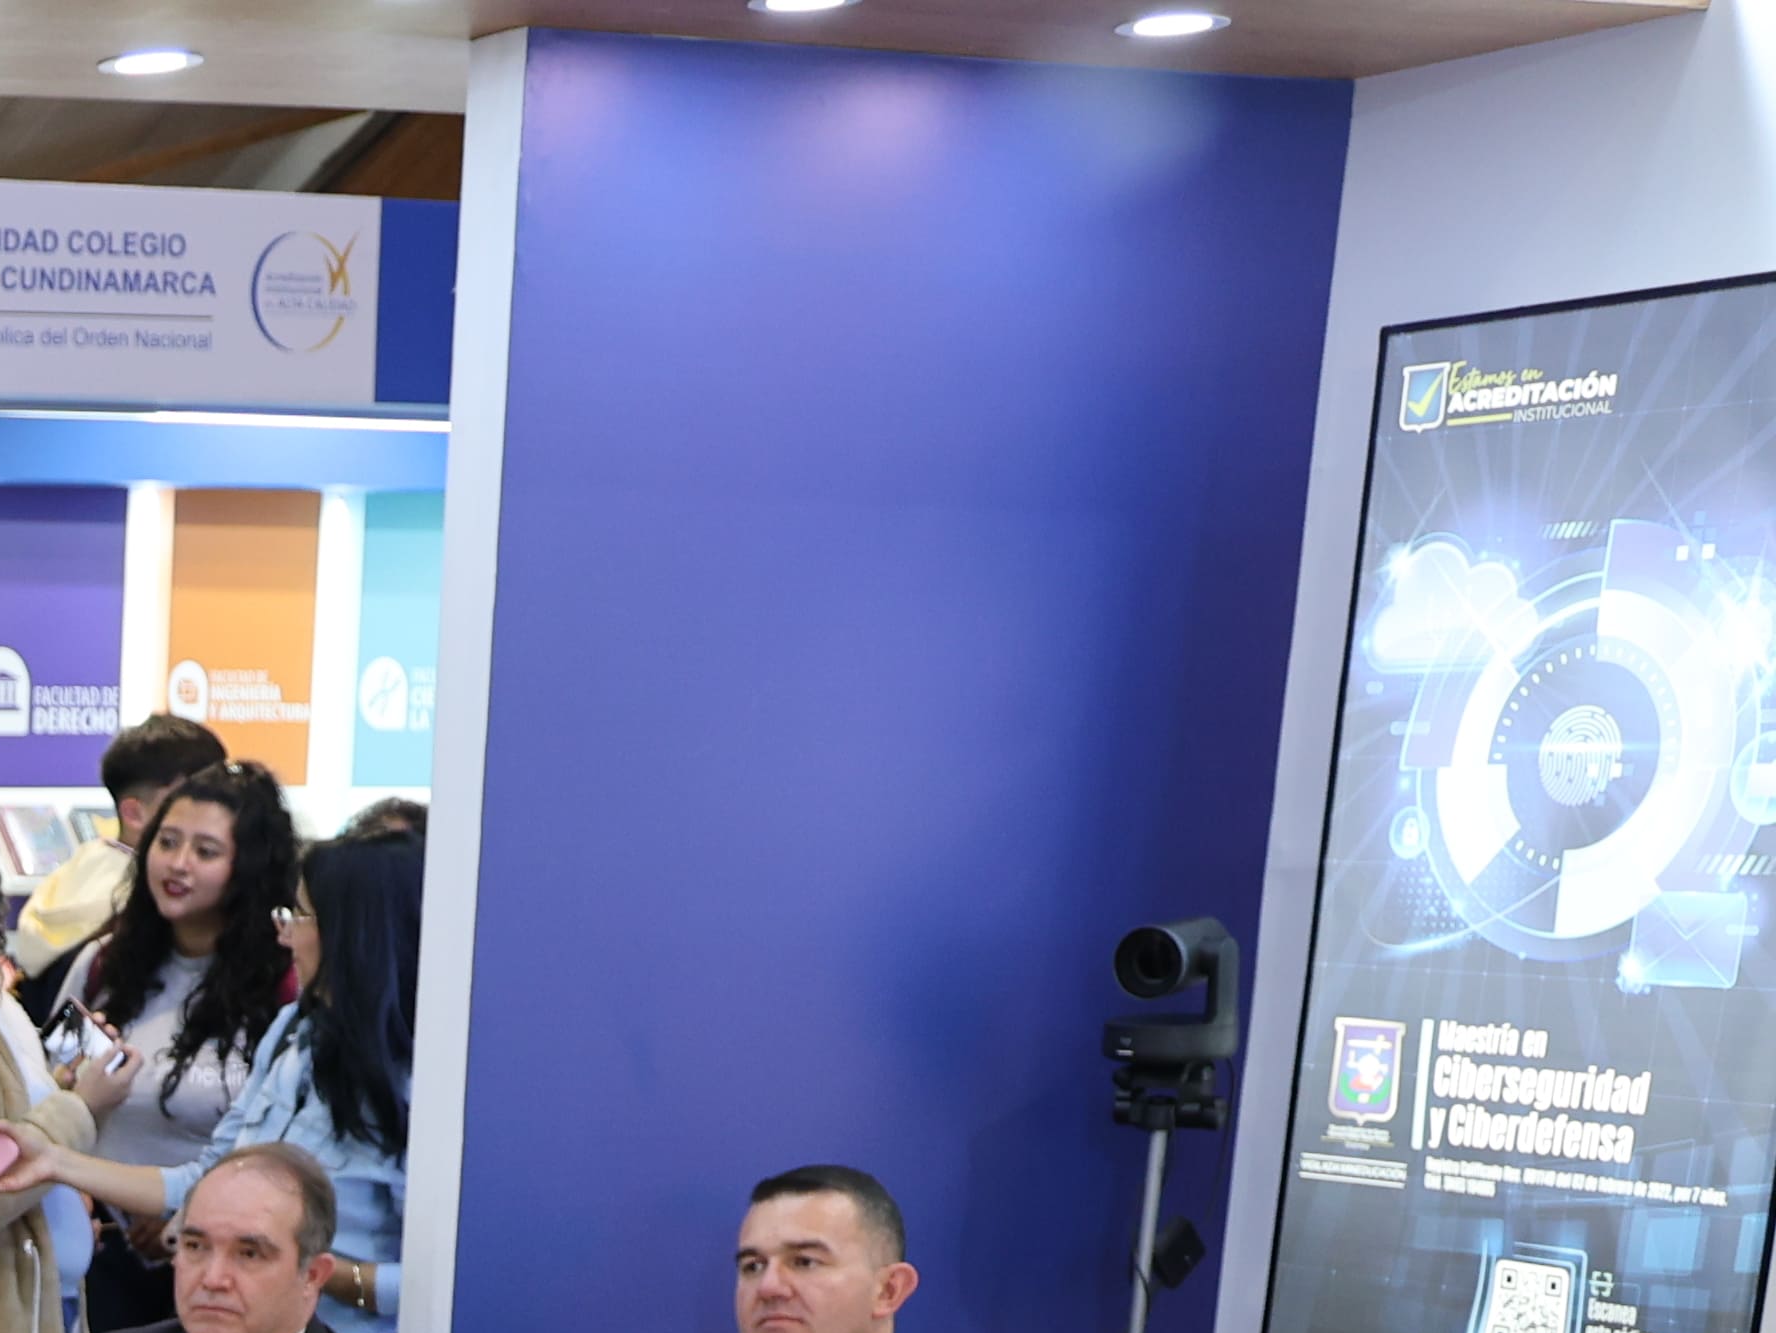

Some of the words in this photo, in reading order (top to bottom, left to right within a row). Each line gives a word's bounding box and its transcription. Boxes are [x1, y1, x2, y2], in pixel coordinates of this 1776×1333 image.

[67, 231, 186, 258] COLEGIO
[1, 267, 216, 296] CUNDINAMARCA
[41, 327, 67, 346] del
[72, 327, 129, 347] Orden
[135, 330, 212, 351] Nacional
[1449, 360, 1517, 393] Estamos
[1521, 368, 1544, 383] en
[1448, 370, 1618, 413] ACREDITACIÓN
[1513, 401, 1613, 423] INSTITUCIONAL
[34, 685, 97, 706] FACULTAD
[103, 686, 120, 706] DE
[33, 707, 119, 735] DERECHO
[1437, 1019, 1520, 1056] Maestría
[1522, 1029, 1548, 1058] en
[1433, 1055, 1651, 1115] Ciberseguridad
[1428, 1107, 1446, 1149] y
[1448, 1103, 1634, 1164] Ciberdefensa
[1588, 1297, 1637, 1326] Escanea
